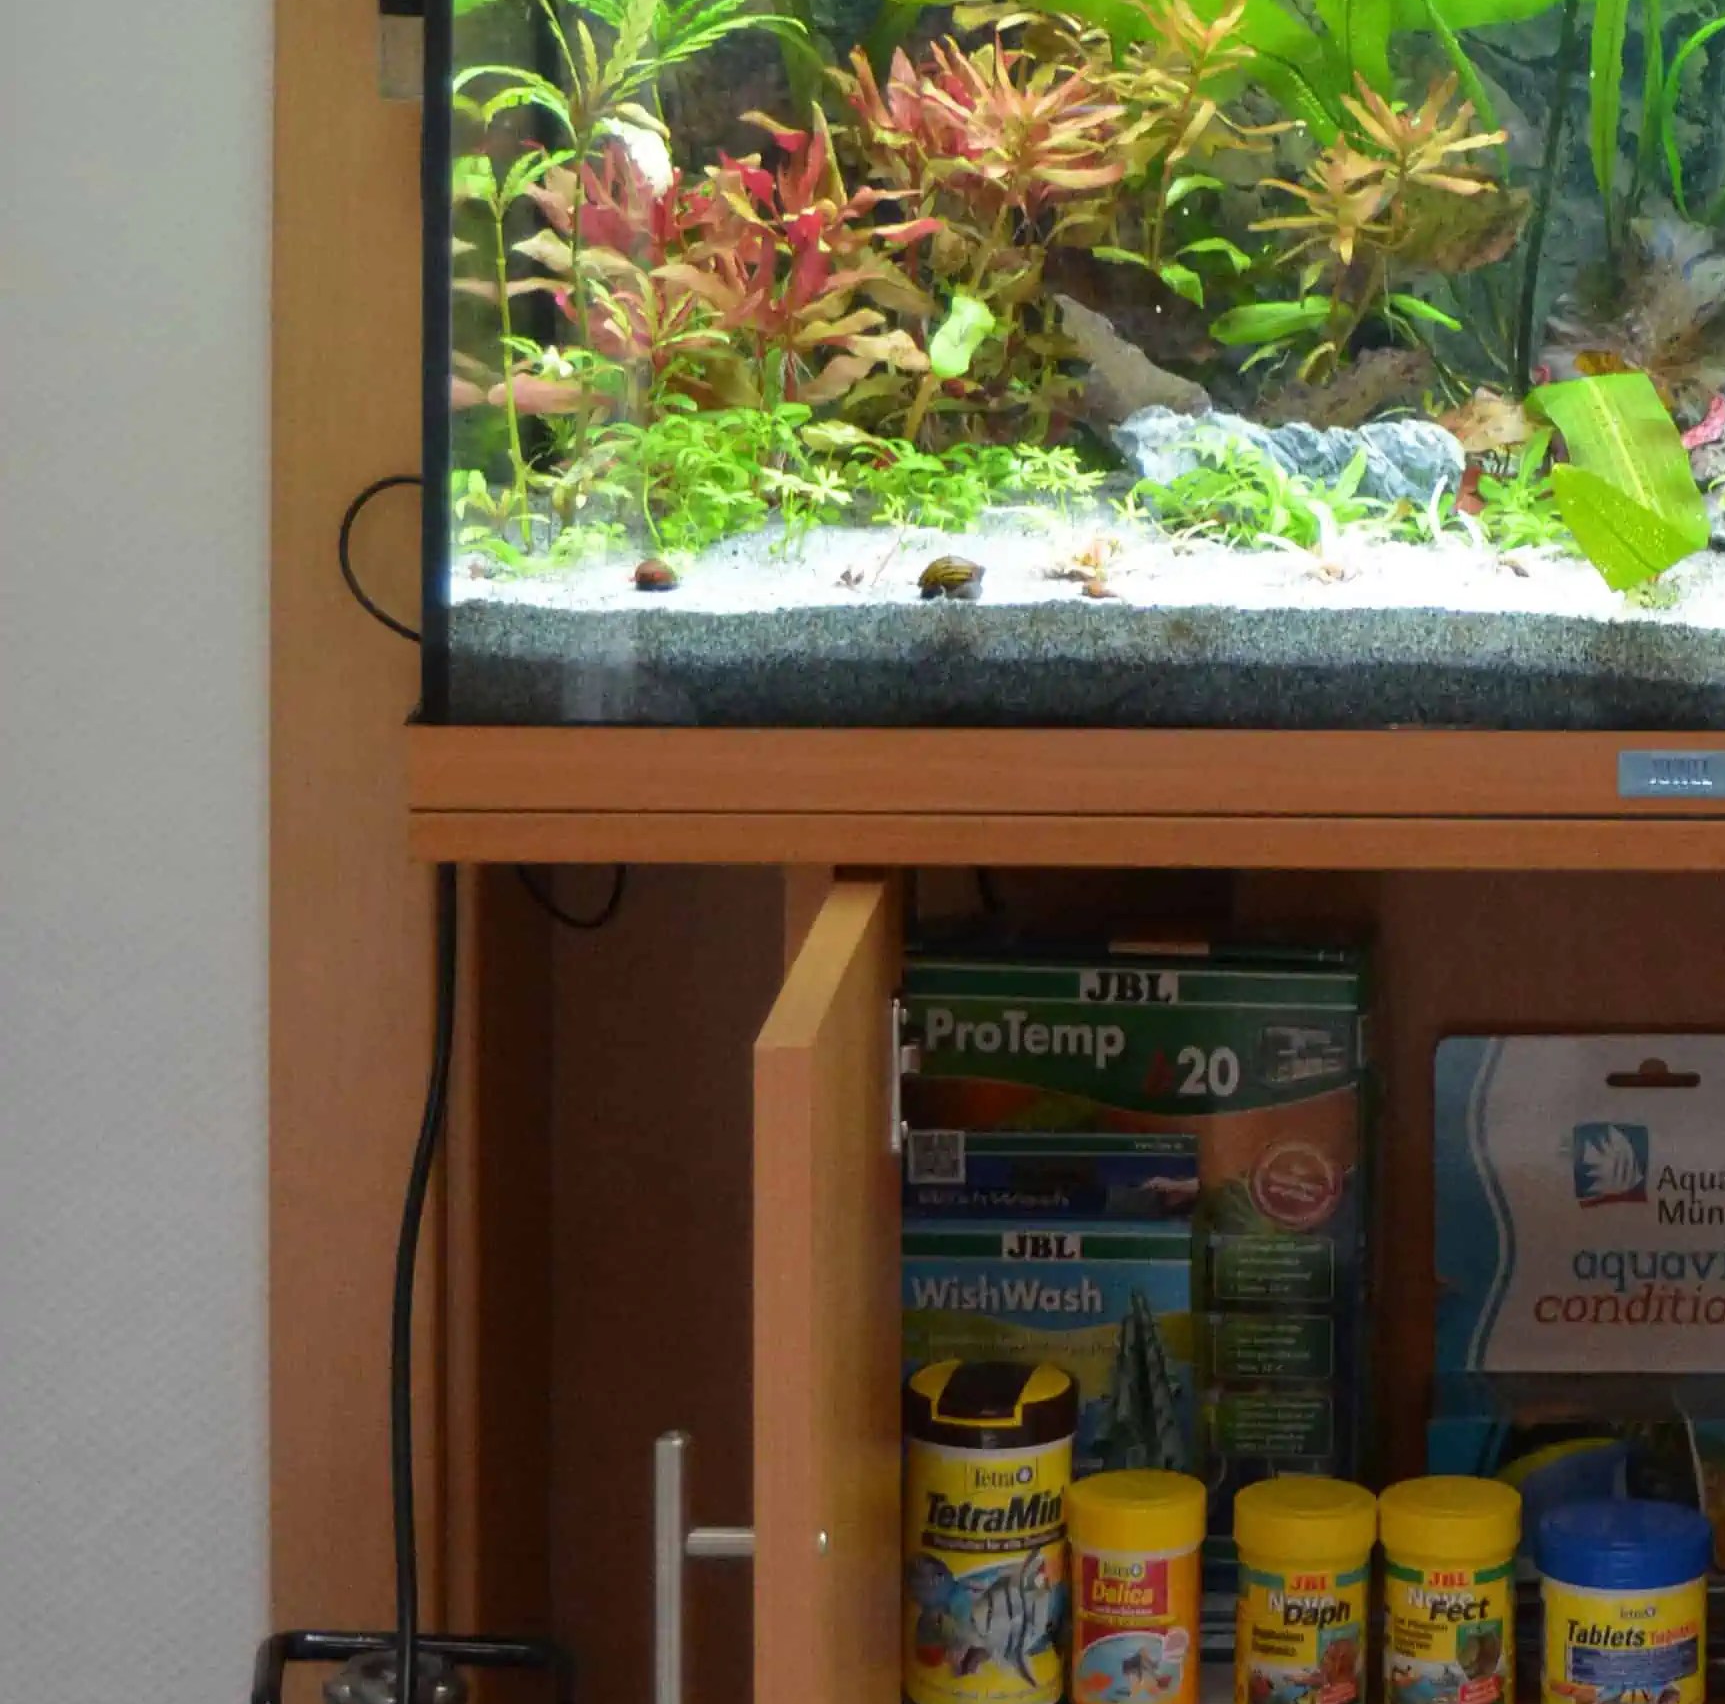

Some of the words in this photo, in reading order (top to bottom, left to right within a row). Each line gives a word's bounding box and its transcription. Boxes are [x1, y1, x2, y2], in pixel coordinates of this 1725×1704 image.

[1086, 972, 1174, 1003] JBL
[926, 1008, 1126, 1069] ProTemp
[1176, 1045, 1241, 1097] 20
[1007, 1233, 1077, 1260] JBL
[911, 1271, 1104, 1314] WishWash
[1430, 1596, 1490, 1622] Fect
[1567, 1618, 1645, 1647] Tablets
